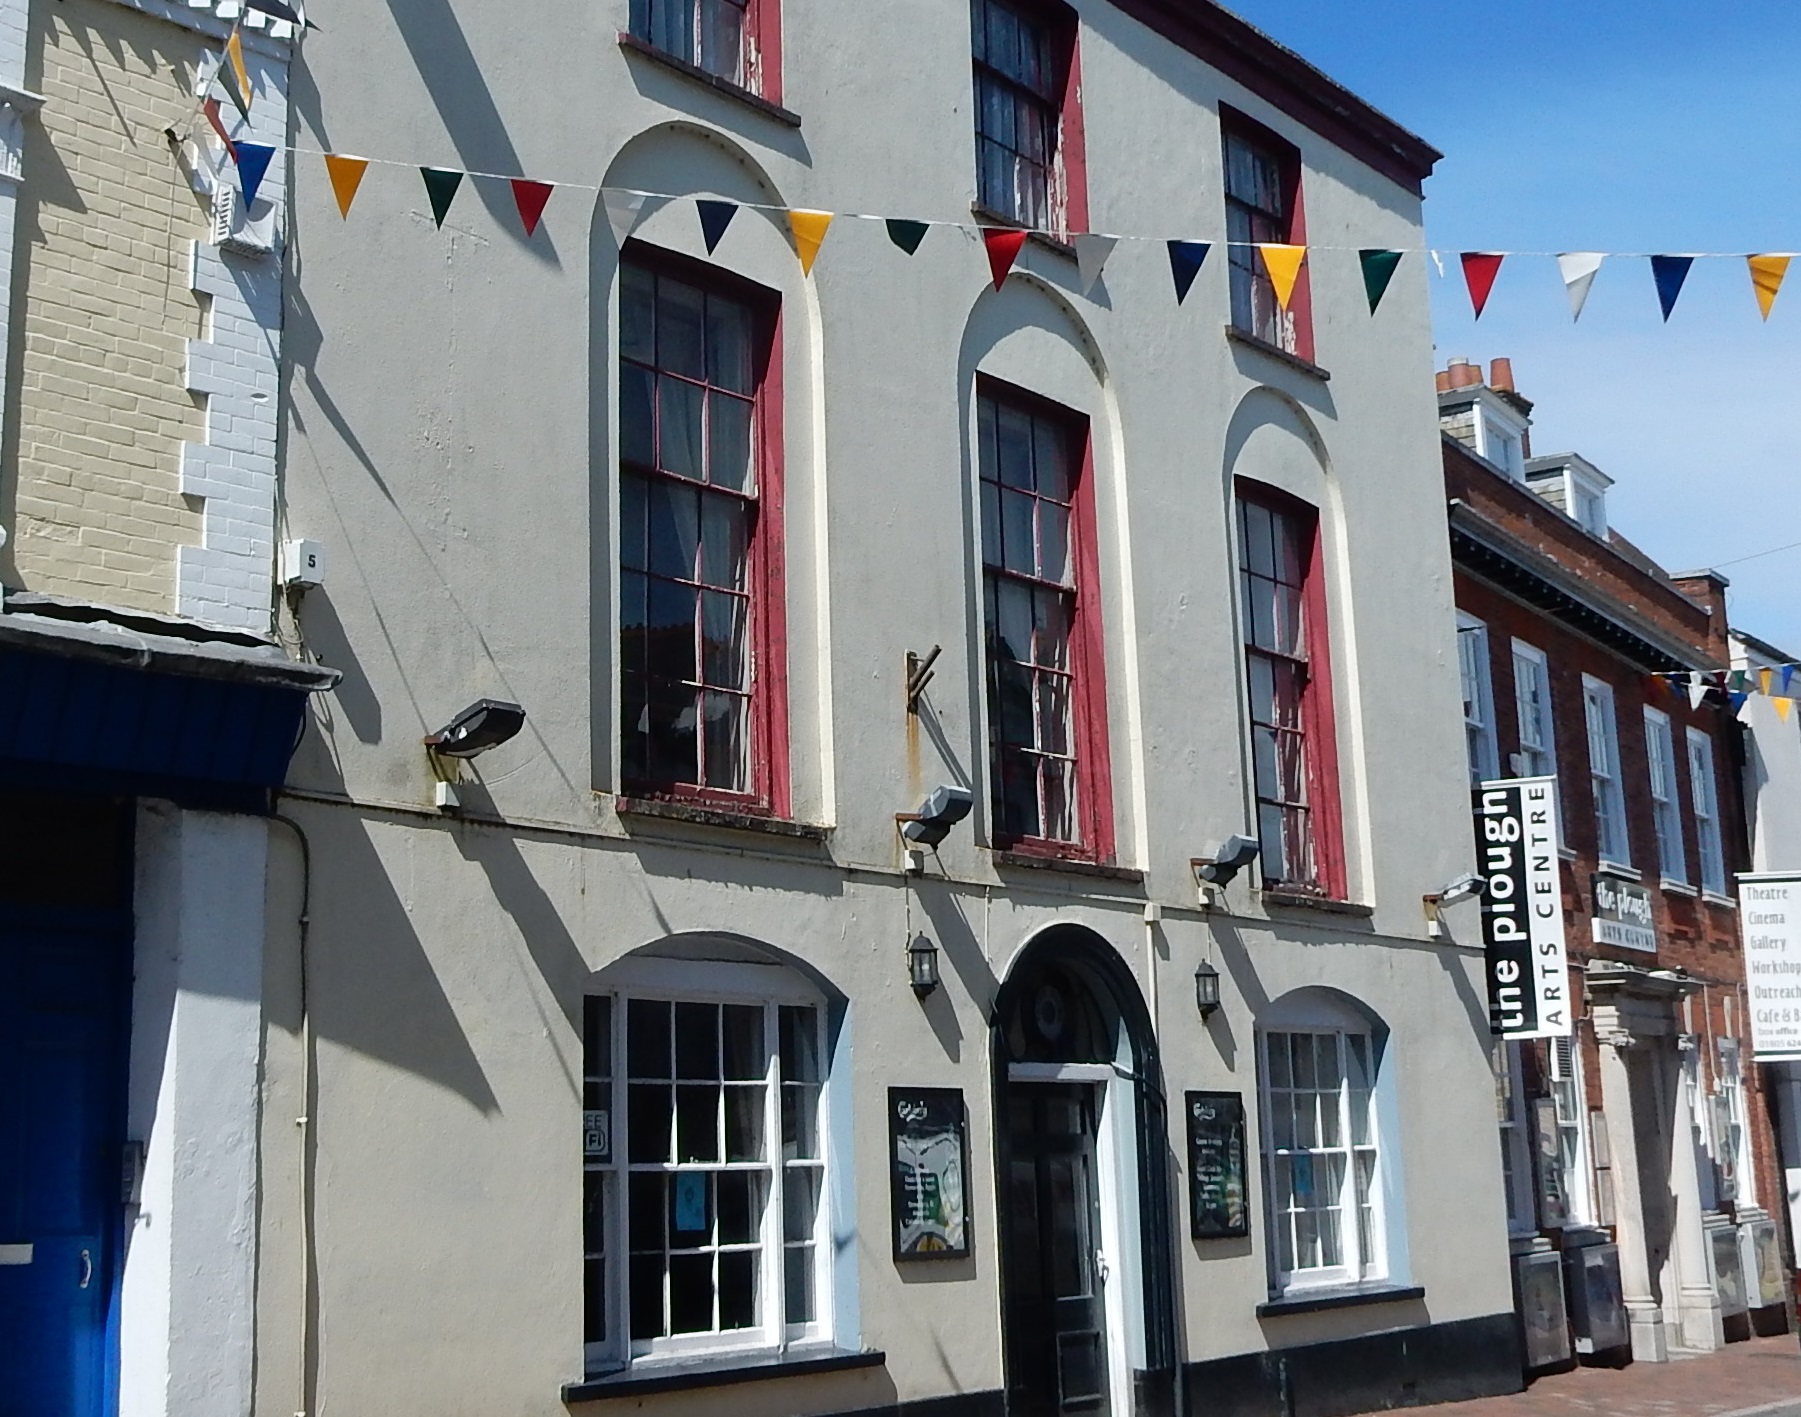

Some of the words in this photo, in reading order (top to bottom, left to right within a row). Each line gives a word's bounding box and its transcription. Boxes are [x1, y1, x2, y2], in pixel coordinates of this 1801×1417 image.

[308, 554, 316, 568] 5
[1528, 787, 1555, 919] CENTRE
[1747, 887, 1789, 900] Theatre
[1596, 881, 1616, 910] the
[1617, 887, 1652, 925] plough
[1748, 911, 1786, 925] Cinema
[1751, 936, 1787, 951] Gallery
[1539, 942, 1564, 1027] ARTS
[1757, 1008, 1781, 1023] Cafe
[1782, 1008, 1791, 1022] &
[1793, 1008, 1801, 1022] B
[586, 1114, 602, 1130] EE
